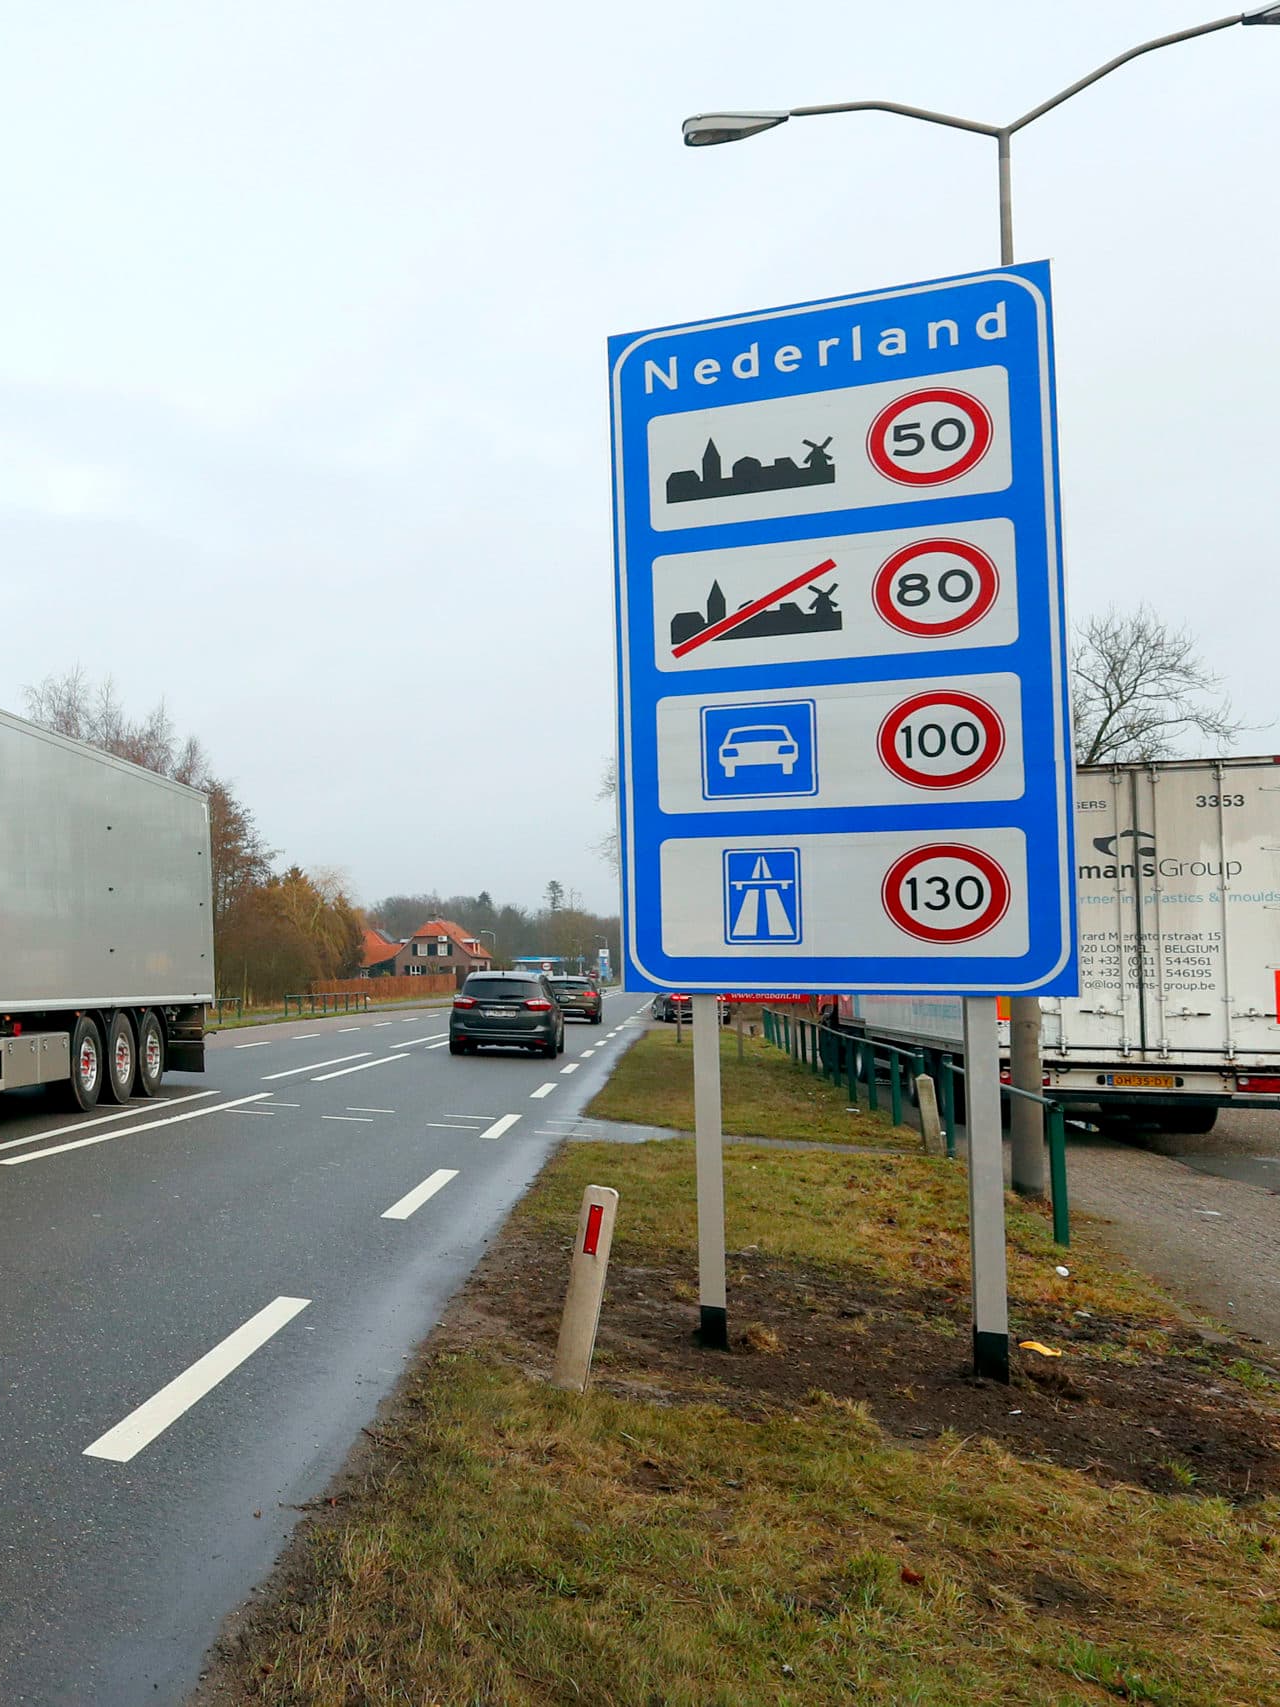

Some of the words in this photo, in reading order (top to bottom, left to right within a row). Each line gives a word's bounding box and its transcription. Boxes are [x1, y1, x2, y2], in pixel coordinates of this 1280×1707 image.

[644, 301, 1008, 394] Nederland
[892, 417, 966, 457] 50
[896, 568, 974, 607] 80
[901, 721, 980, 759] 100
[1196, 794, 1245, 808] 3353
[905, 875, 985, 911] 130
[1144, 892, 1204, 904] plastics
[1209, 892, 1219, 903] &
[1229, 891, 1280, 902] moulds
[1208, 932, 1221, 941] 15
[1164, 944, 1220, 954] BELGIUM
[1098, 956, 1120, 965] +32
[1165, 956, 1212, 966] 544561
[1098, 968, 1120, 977] +32
[1166, 968, 1212, 978] 546195
